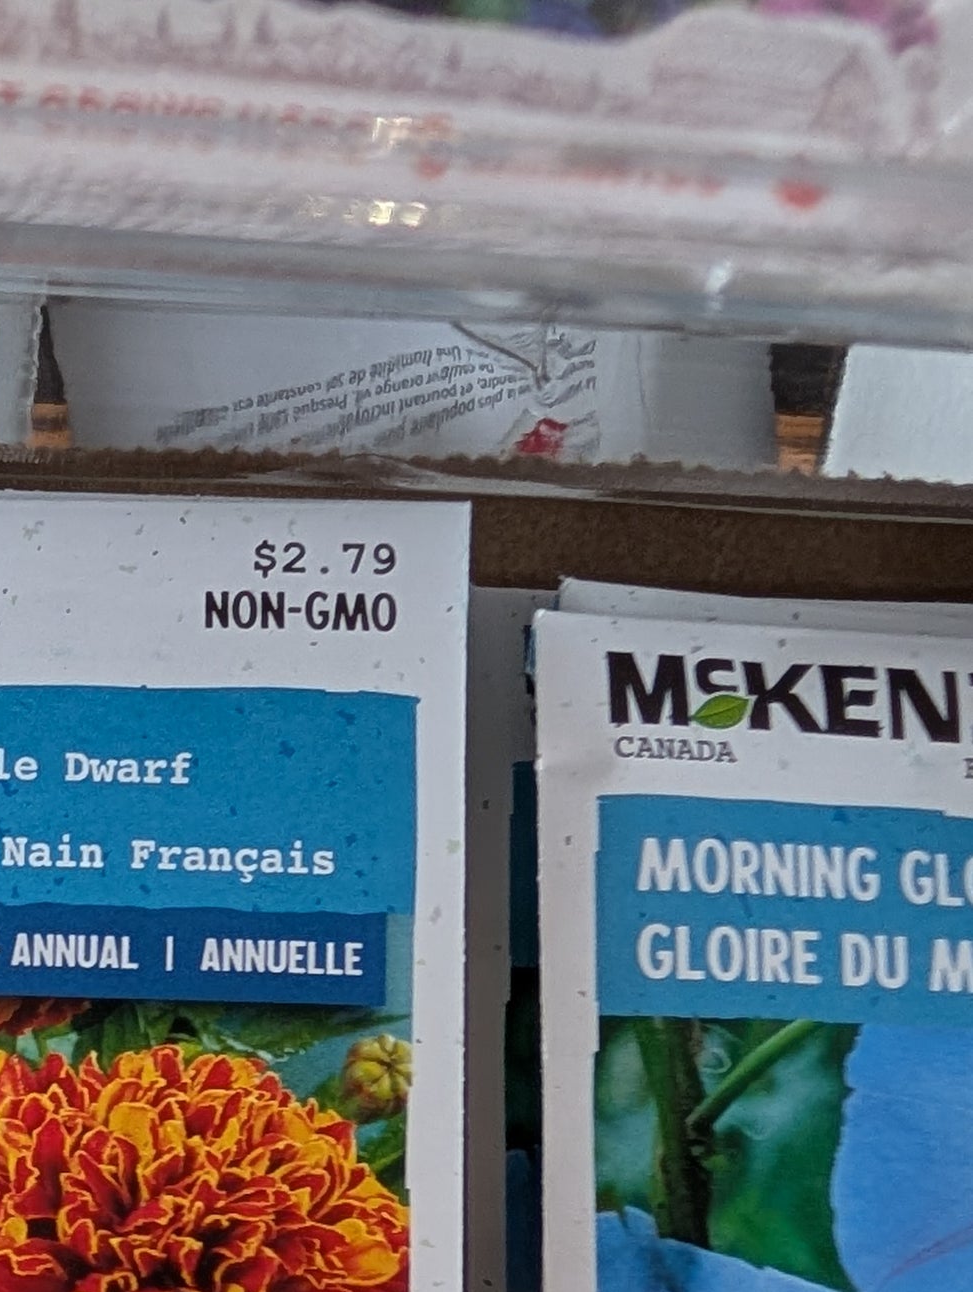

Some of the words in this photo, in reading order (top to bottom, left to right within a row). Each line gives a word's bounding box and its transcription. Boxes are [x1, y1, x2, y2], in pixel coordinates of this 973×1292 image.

[253, 539, 397, 579] $2.79
[204, 590, 397, 632] NON-GMO
[606, 651, 973, 744] McKEN
[65, 752, 193, 785] Dwarf
[614, 736, 738, 763] CANADA
[2, 836, 104, 869] Nain
[130, 840, 336, 884] Français
[636, 837, 880, 902] MORNING
[11, 933, 138, 971] ANNUAL
[200, 938, 364, 977] ANNUELLE
[636, 923, 823, 985] GLOIRE
[840, 933, 909, 989] DU
